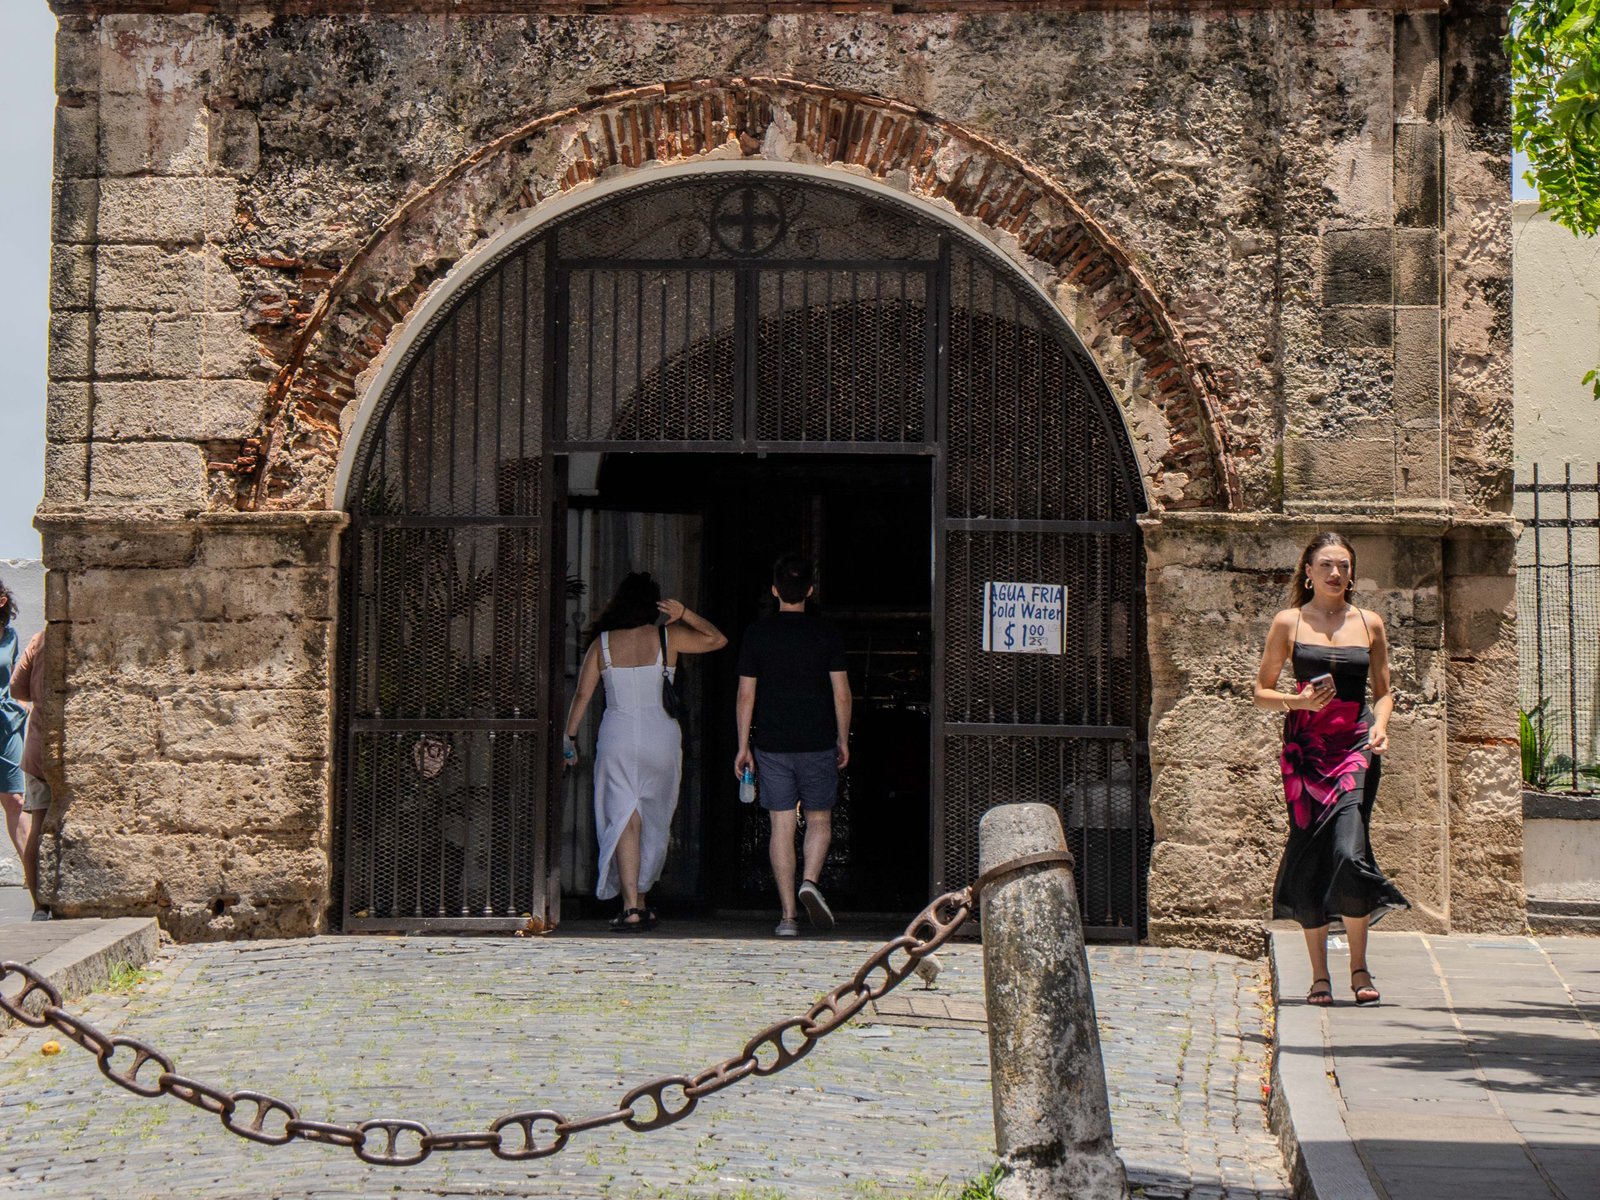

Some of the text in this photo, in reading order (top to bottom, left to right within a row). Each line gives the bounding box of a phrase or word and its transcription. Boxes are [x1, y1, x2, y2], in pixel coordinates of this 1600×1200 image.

[991, 584, 1063, 604] AGUA FRIA
[992, 601, 1062, 620] Cold Water
